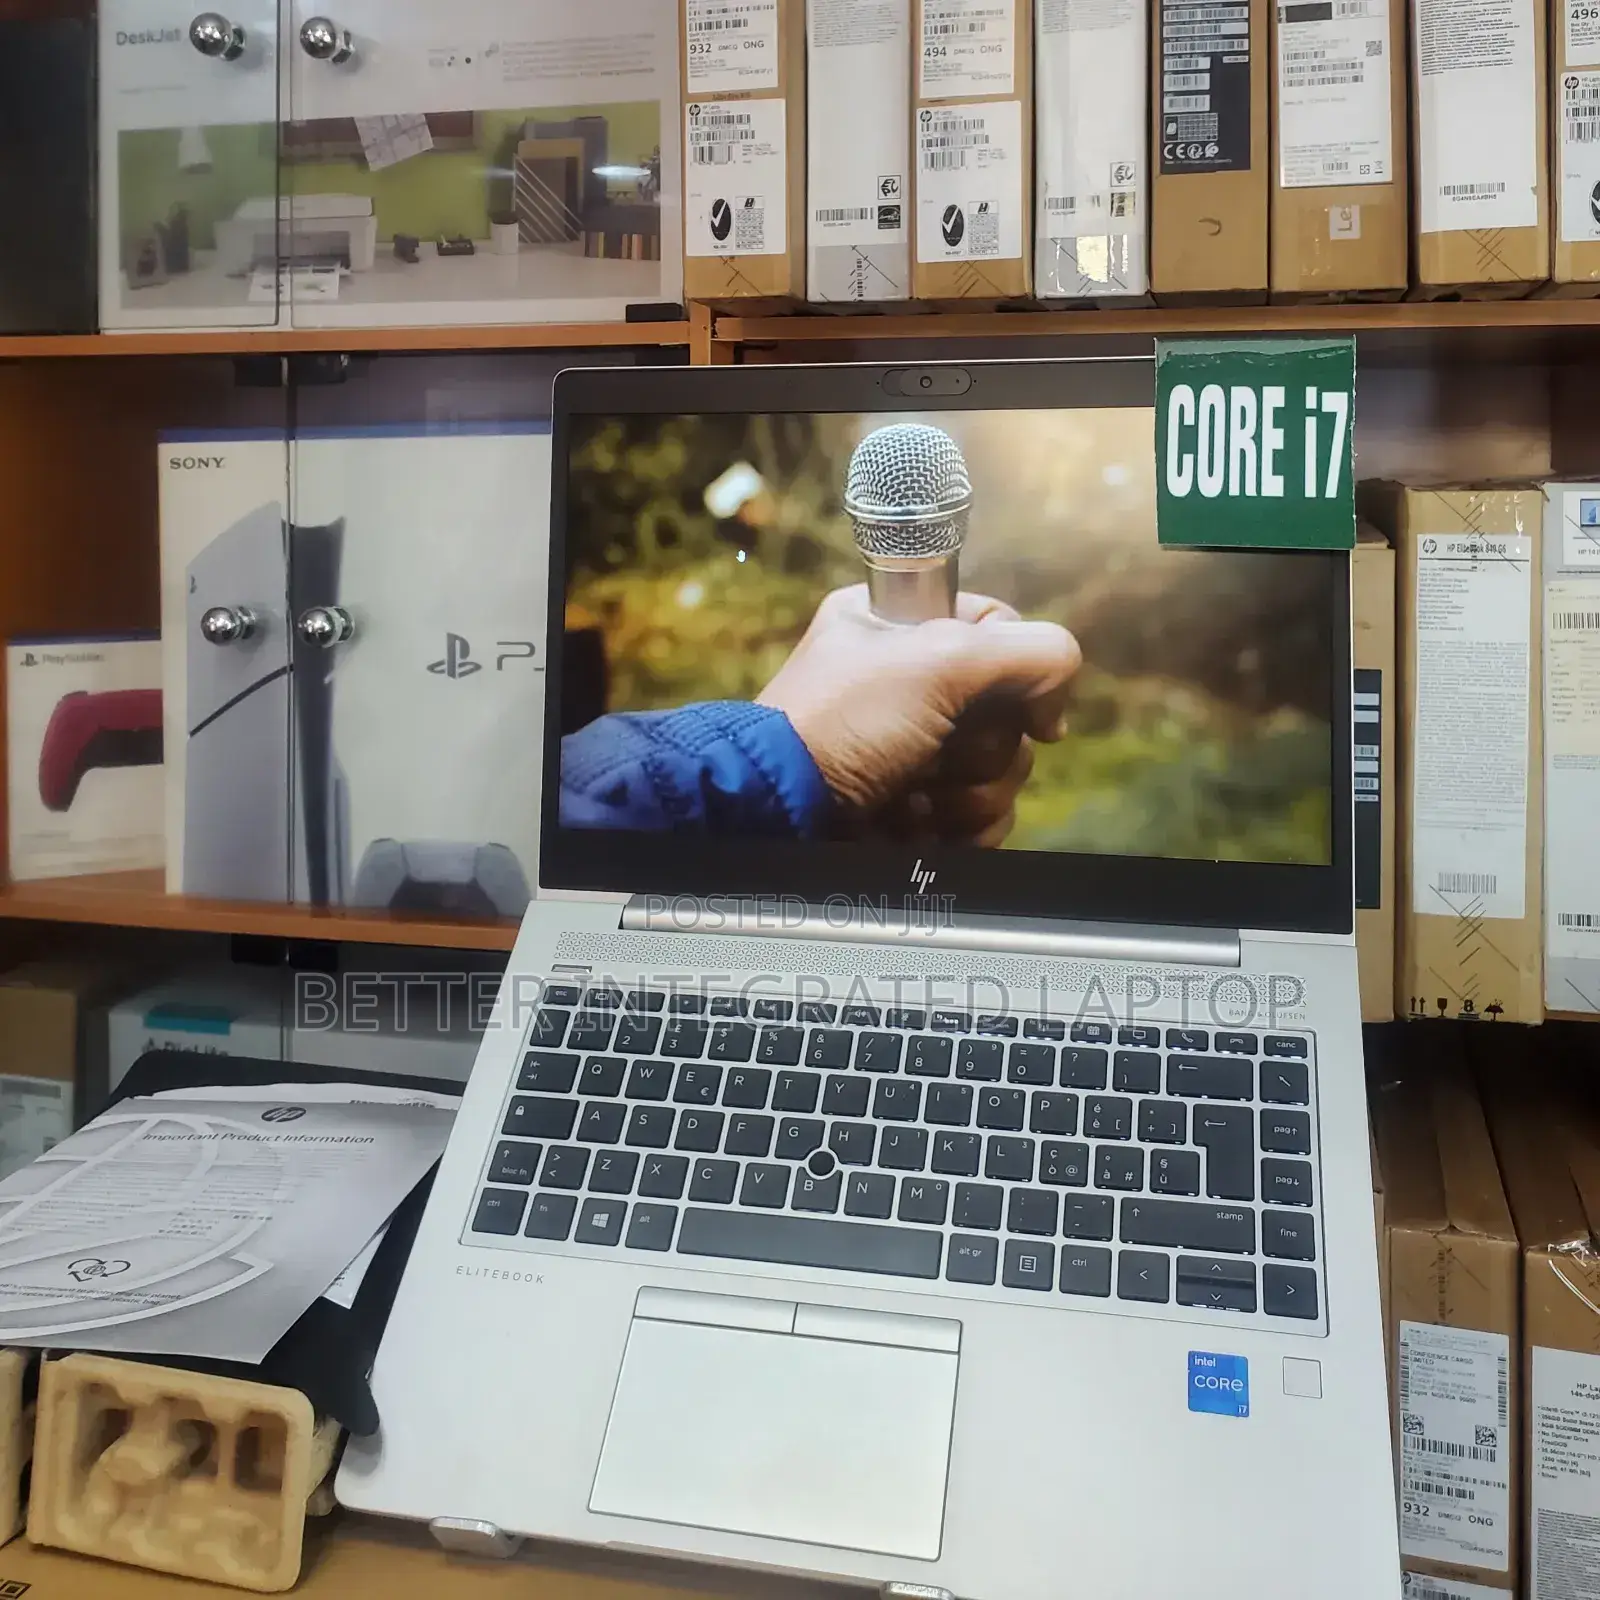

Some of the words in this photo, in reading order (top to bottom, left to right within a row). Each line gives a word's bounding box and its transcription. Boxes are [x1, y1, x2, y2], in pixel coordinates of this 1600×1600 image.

[1570, 7, 1599, 21] 496
[689, 43, 713, 55] 932
[743, 40, 765, 50] ONG
[924, 46, 948, 58] 494
[980, 44, 1003, 55] ONG
[1165, 383, 1285, 500] CORE
[1303, 385, 1350, 500] i7
[168, 456, 226, 471] SONY
[496, 641, 545, 672] P
[622, 1036, 630, 1045] 2
[669, 1040, 677, 1048] 3
[1275, 1040, 1297, 1049] canc
[716, 1043, 725, 1051] 4
[765, 1047, 773, 1055] 5
[814, 1049, 822, 1058] 6
[864, 1053, 872, 1062] 7
[915, 1057, 923, 1066] 8
[965, 1061, 974, 1071] 9
[591, 1064, 603, 1075] Q
[640, 1068, 654, 1078] W
[686, 1072, 695, 1082] E
[734, 1075, 744, 1085] R
[784, 1079, 793, 1088] T
[835, 1083, 845, 1093] Y
[885, 1088, 895, 1097] U
[1041, 1100, 1050, 1110] P
[590, 1111, 600, 1121] A
[639, 1115, 647, 1125] S
[688, 1119, 698, 1128] D
[737, 1123, 746, 1133] F
[788, 1127, 799, 1137] G
[1274, 1126, 1290, 1134] pag
[142, 1132, 218, 1143] Important
[221, 1131, 282, 1144] Product
[284, 1133, 376, 1146] Information
[839, 1131, 849, 1142] H
[890, 1136, 898, 1146] J
[943, 1141, 954, 1152] K
[996, 1146, 1005, 1157] L
[602, 1159, 612, 1170] Z
[651, 1164, 662, 1175] X
[701, 1169, 713, 1179] C
[754, 1173, 764, 1183] V
[804, 1180, 814, 1191] B
[1275, 1176, 1292, 1185] pag
[857, 1182, 868, 1193] N
[911, 1188, 923, 1199] M
[487, 1199, 501, 1208] ctrl
[639, 1215, 650, 1223] alt
[1216, 1212, 1244, 1221] stamp
[1280, 1229, 1297, 1238] fine
[958, 1247, 971, 1255] alt
[1072, 1258, 1087, 1267] ctrl
[455, 1265, 546, 1284] ELITEBOOK
[1194, 1355, 1217, 1369] intel
[1238, 1404, 1248, 1415] i7
[1403, 1501, 1431, 1518] 932
[1467, 1514, 1495, 1528] ONG
